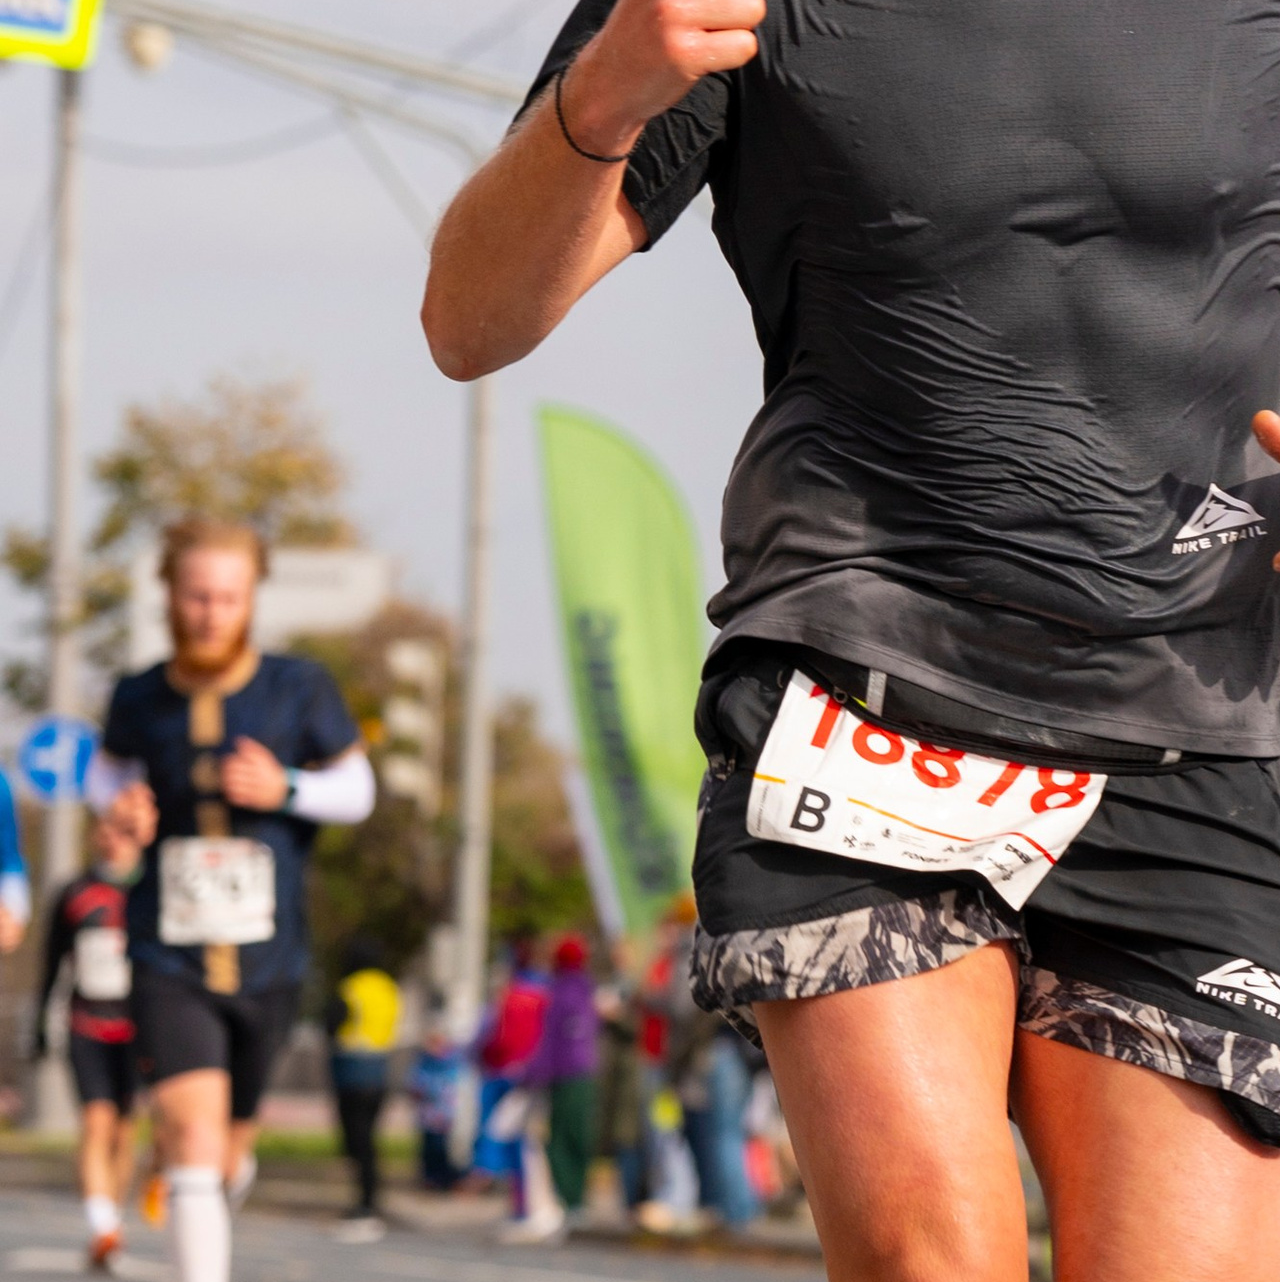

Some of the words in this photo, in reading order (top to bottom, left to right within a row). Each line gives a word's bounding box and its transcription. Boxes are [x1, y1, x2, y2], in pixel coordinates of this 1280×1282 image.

[1171, 537, 1212, 555] NIKE
[1216, 525, 1268, 545] TRAIL
[790, 786, 832, 833] B
[1196, 982, 1248, 1006] NIKE
